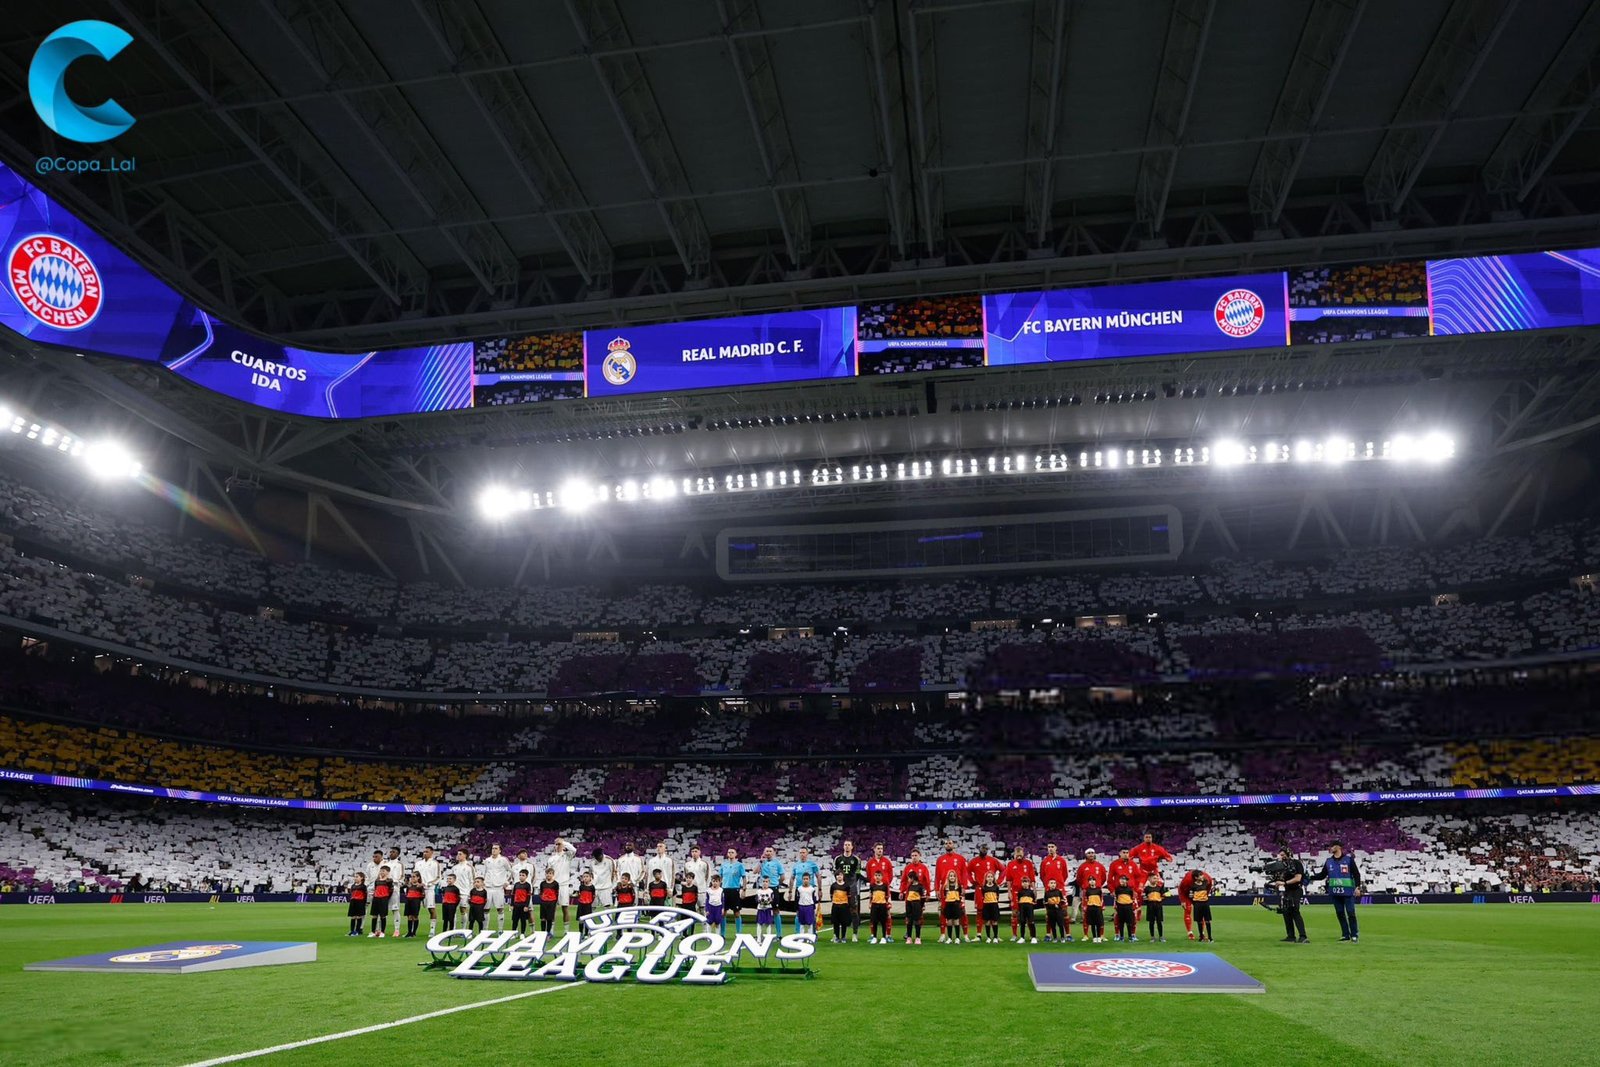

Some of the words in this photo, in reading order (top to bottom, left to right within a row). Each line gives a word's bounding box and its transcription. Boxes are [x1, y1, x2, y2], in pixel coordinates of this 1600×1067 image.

[23, 239, 46, 258] FC
[50, 239, 98, 298] BAYERN
[1227, 291, 1260, 309] BAYERN
[1023, 321, 1041, 334] FC
[1044, 316, 1102, 333] BAYERN
[1106, 310, 1183, 329] MÜNCHEN
[682, 347, 716, 362] REAL
[719, 342, 775, 359] MADRID
[777, 341, 790, 354] C.
[793, 339, 804, 353] F.
[231, 350, 307, 381] CUARTOS
[251, 372, 281, 391] IDA
[6, 772, 34, 780] LEAGUE
[232, 796, 266, 804] CHAMPIONS
[28, 895, 55, 904] UEFA
[144, 895, 166, 904] UEFA
[236, 895, 255, 903] UEFA
[1394, 896, 1420, 904] UEFA
[1508, 896, 1535, 904] UEFA
[582, 910, 695, 934] UEFA
[424, 928, 819, 960] CHAMPIONS
[448, 951, 733, 984] LEAGUE
